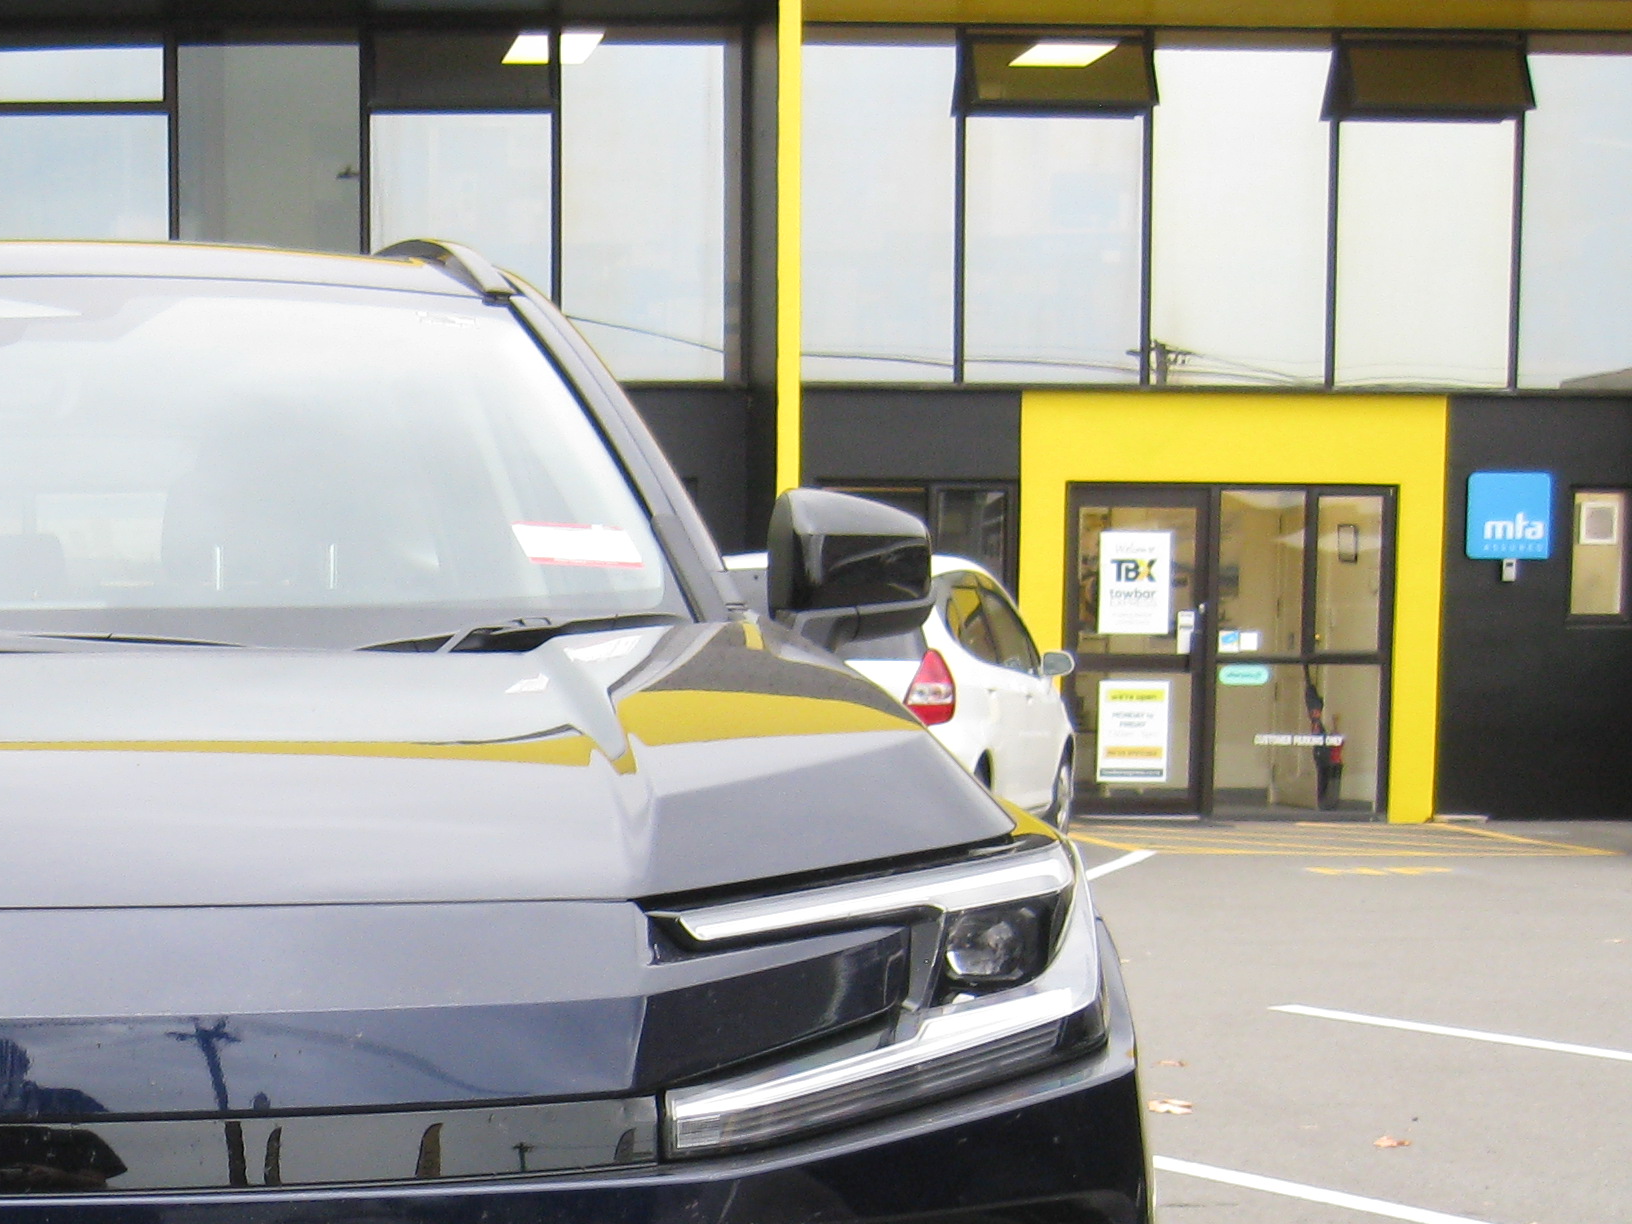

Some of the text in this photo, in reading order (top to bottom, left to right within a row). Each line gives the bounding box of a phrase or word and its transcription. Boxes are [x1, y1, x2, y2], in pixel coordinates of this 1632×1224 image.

[1483, 511, 1545, 540] mta
[1110, 558, 1157, 582] TBX
[1109, 587, 1156, 600] towbar
